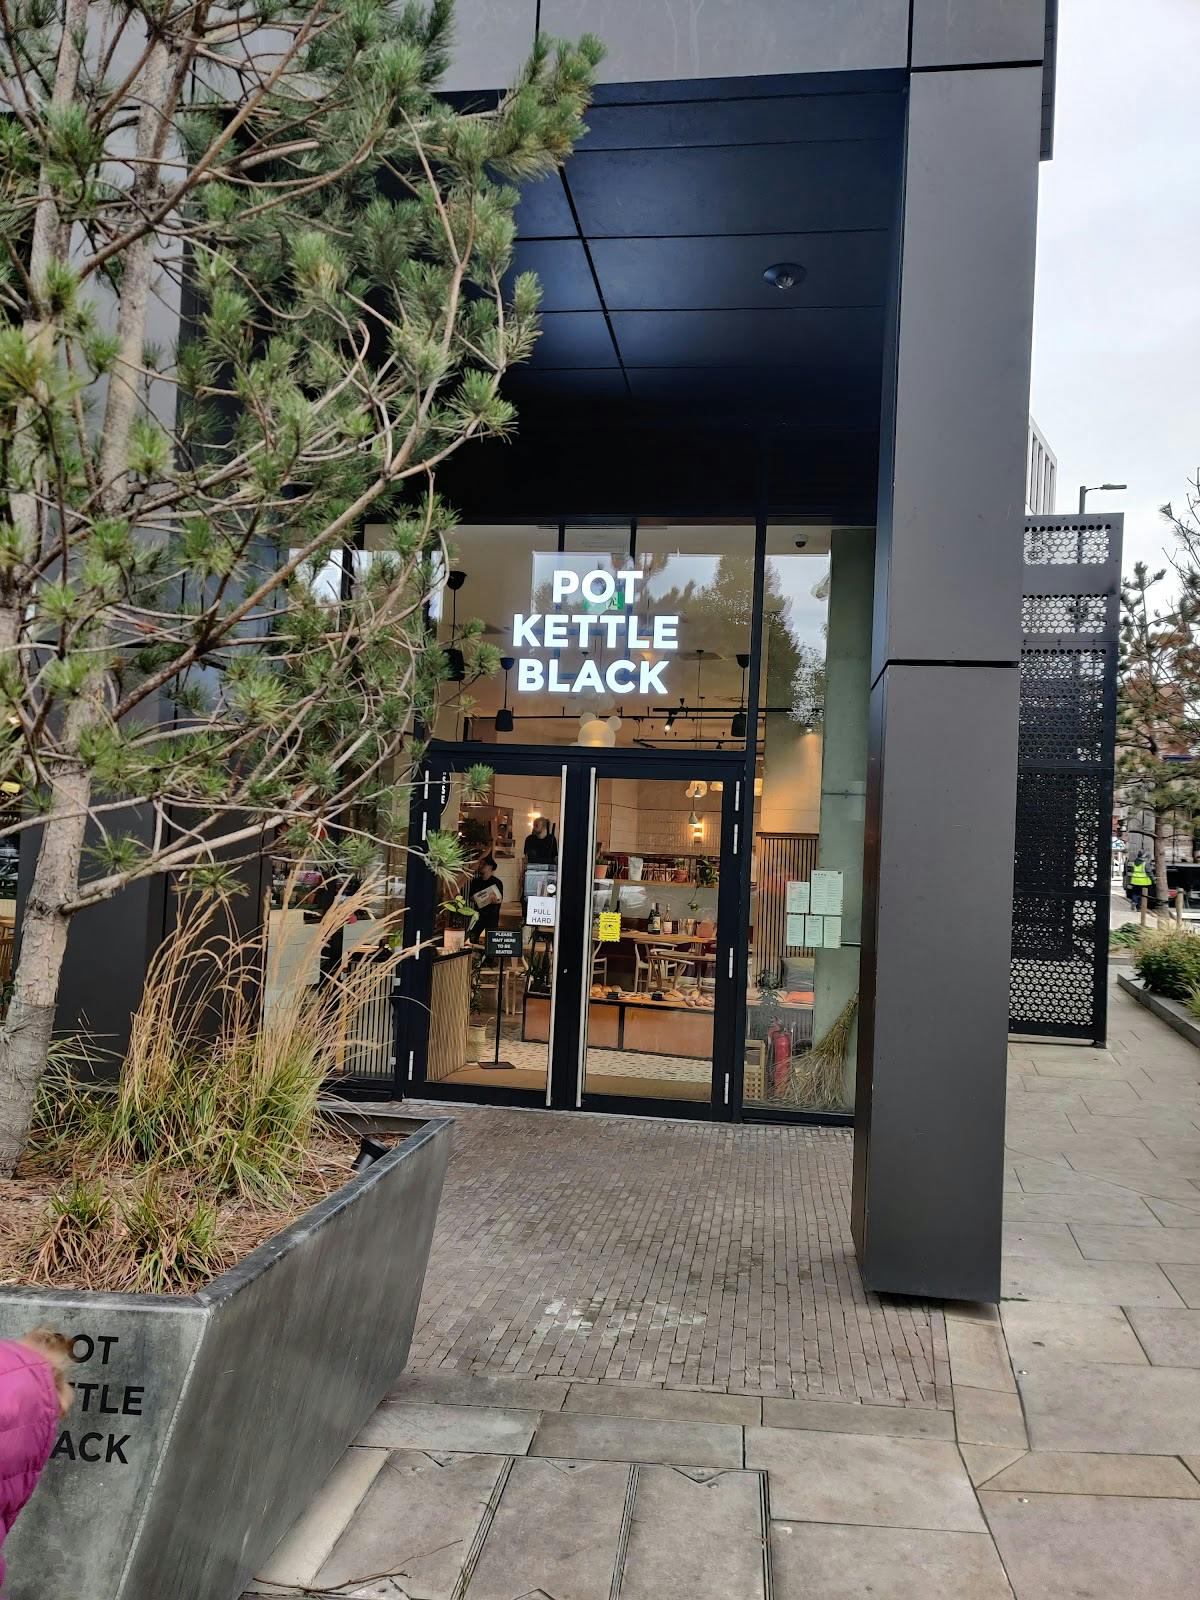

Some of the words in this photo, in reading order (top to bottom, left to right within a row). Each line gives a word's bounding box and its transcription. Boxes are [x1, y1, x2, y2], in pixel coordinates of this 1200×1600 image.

[552, 569, 643, 604] POT
[512, 613, 679, 649] KETTLE
[517, 658, 670, 694] BLACK
[531, 916, 552, 924] HARD
[533, 908, 551, 916] PULL
[56, 1332, 119, 1365] OT
[68, 1381, 145, 1416] TLE
[49, 1429, 132, 1465] ACK
